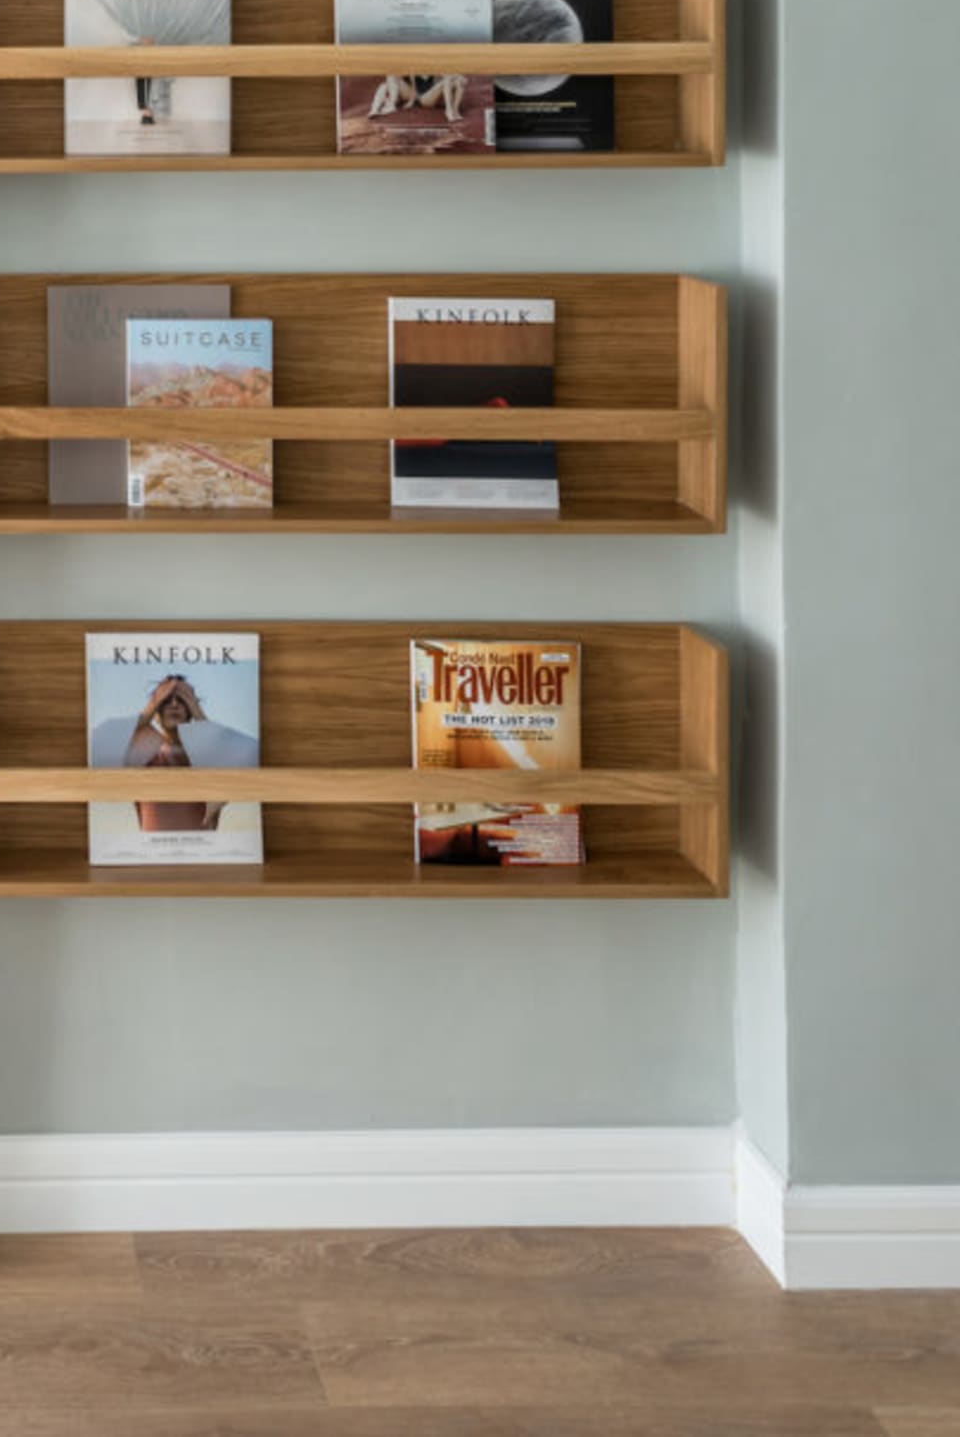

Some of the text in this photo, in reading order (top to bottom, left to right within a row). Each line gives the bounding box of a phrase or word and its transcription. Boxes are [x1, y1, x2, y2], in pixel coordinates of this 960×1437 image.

[417, 308, 531, 326] KINFOLK
[140, 331, 264, 348] SUITCASE
[113, 646, 237, 665] KINFOLK
[426, 649, 570, 706] Traveller
[499, 716, 525, 726] LIST
